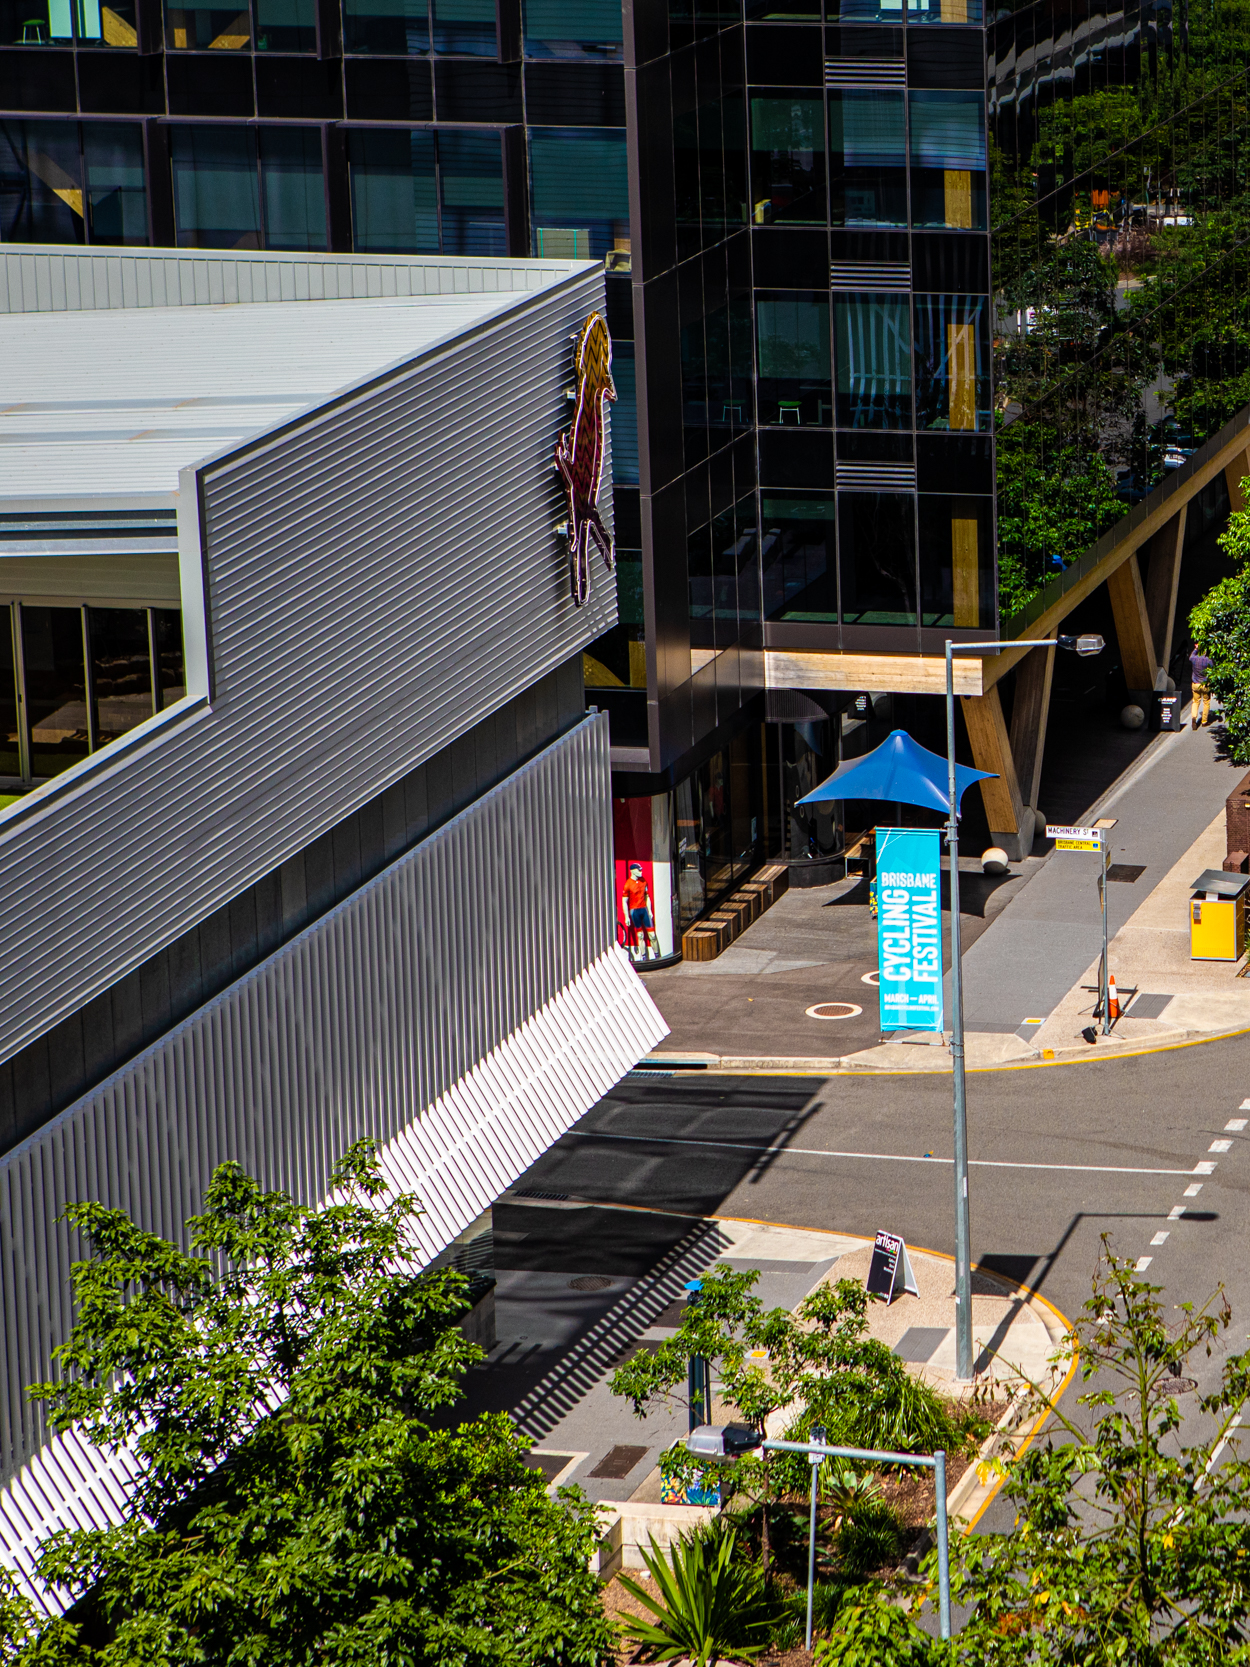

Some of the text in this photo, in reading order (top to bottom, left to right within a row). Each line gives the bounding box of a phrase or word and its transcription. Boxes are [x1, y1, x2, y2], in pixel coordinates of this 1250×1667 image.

[1047, 827, 1081, 836] MACHINERY
[881, 872, 937, 889] BRISBANE
[882, 889, 912, 982] CYCLING
[912, 890, 939, 982] FESTIVAL
[884, 993, 909, 1003] MARCH
[918, 994, 939, 1005] APRIL
[876, 1234, 899, 1252] artisan
[812, 1428, 824, 1437] 2P
